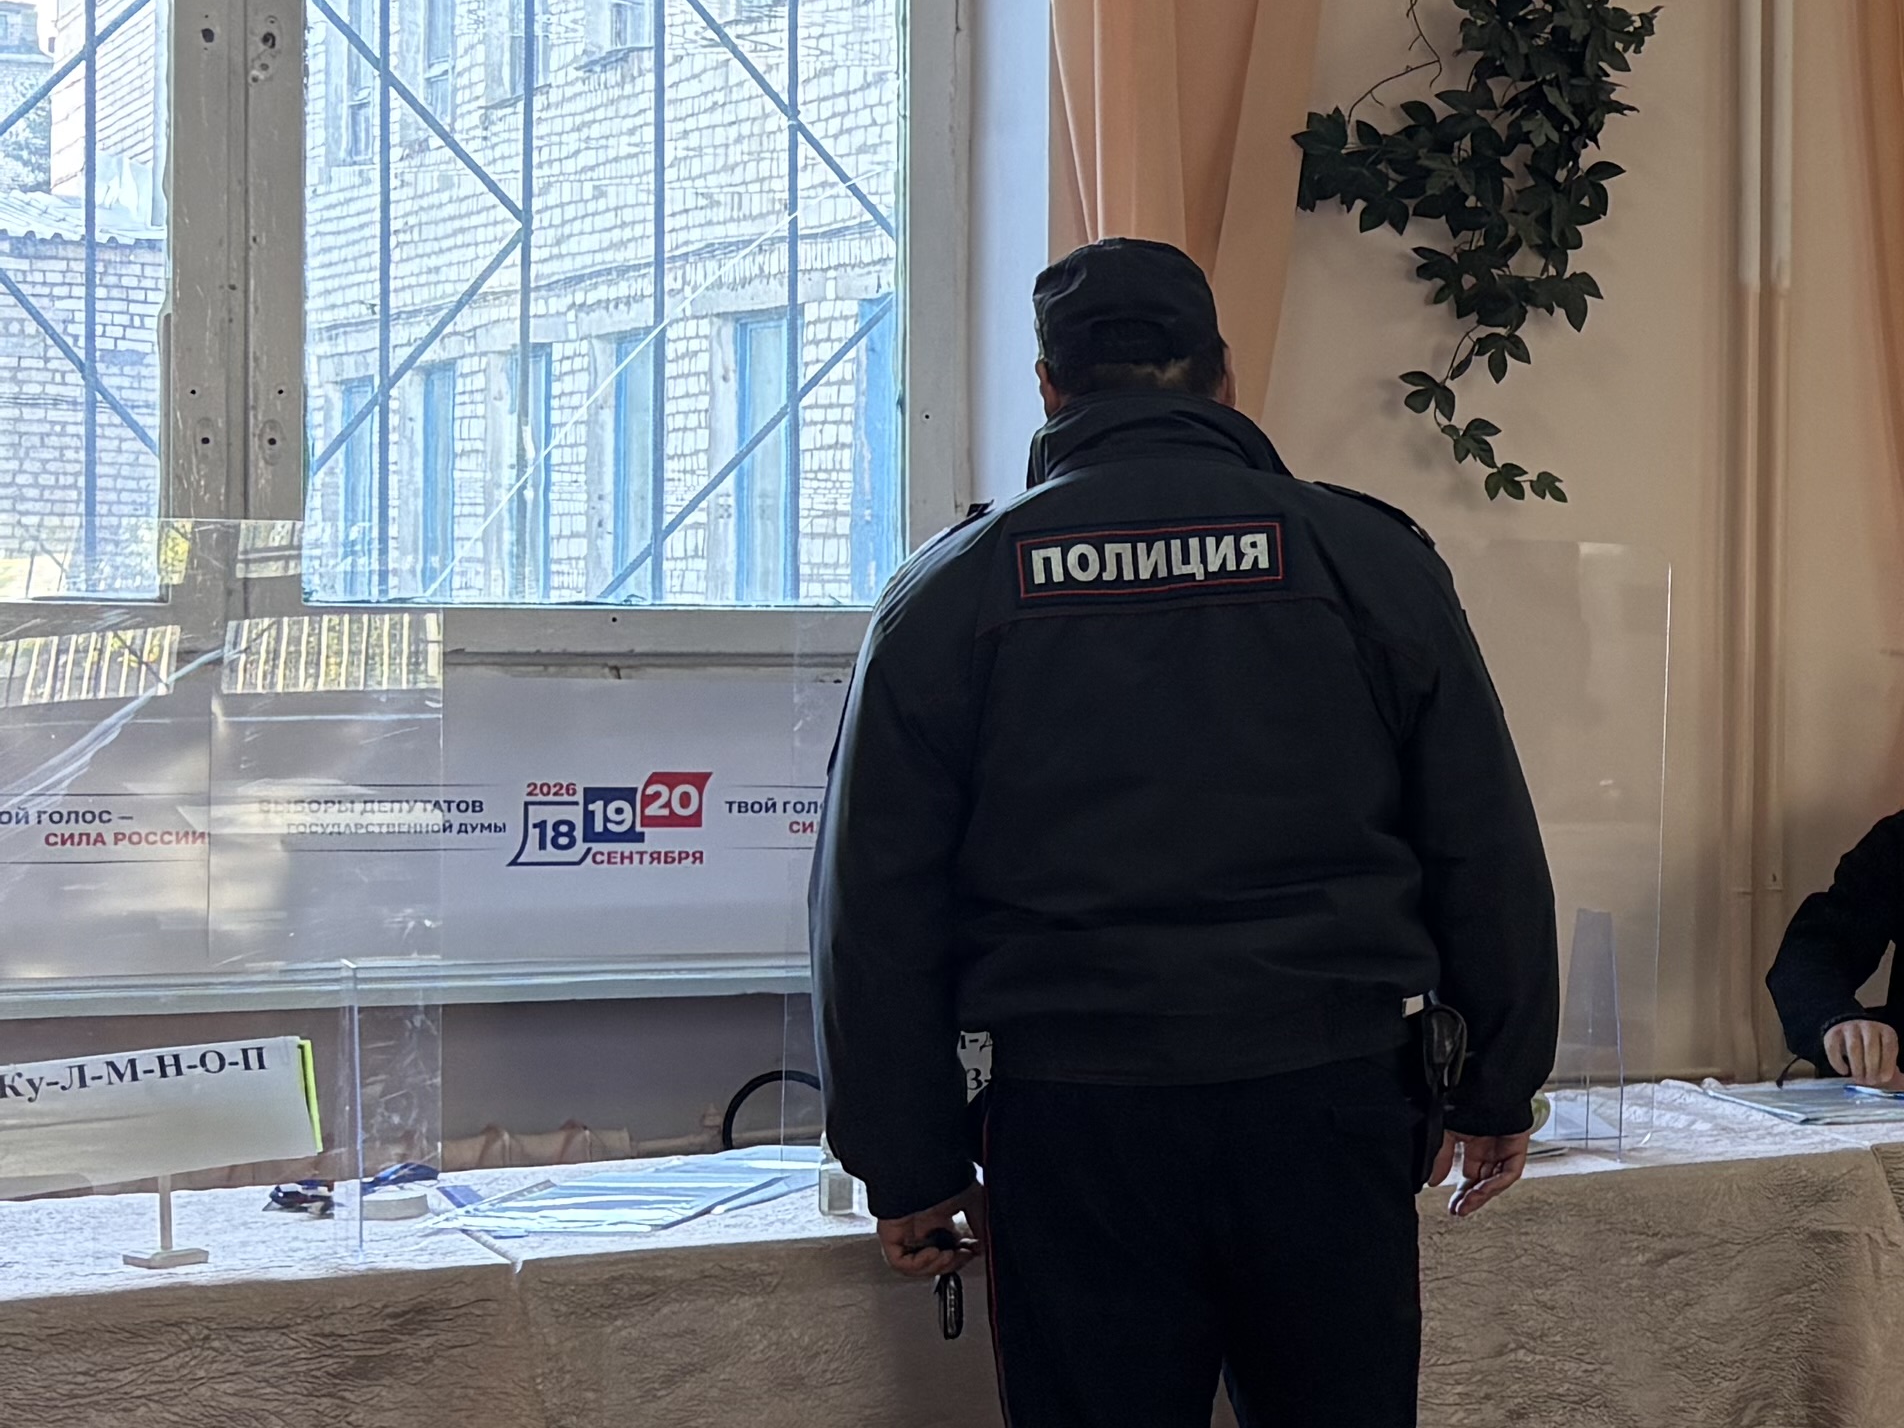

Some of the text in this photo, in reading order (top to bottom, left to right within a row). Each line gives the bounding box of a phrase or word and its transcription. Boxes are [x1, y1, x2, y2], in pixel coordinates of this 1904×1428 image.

[1031, 533, 1270, 585] ПОЛИЦИЯ
[526, 782, 578, 797] 2026
[360, 799, 484, 815] ДЕПУТАТОВ
[644, 784, 700, 817] 20
[725, 797, 777, 814] ТВОЙ
[0, 806, 30, 825] ОЙ
[36, 810, 112, 825] ГОЛОС
[587, 799, 634, 833] 19
[286, 819, 506, 835] ГОСУДАРСТВЕННОЙ ДУМЫ
[532, 819, 577, 851] 18
[788, 821, 818, 834] СИ
[44, 831, 207, 846] СИЛА РОССИИ
[591, 850, 704, 865] СЕНТЯБРЯ
